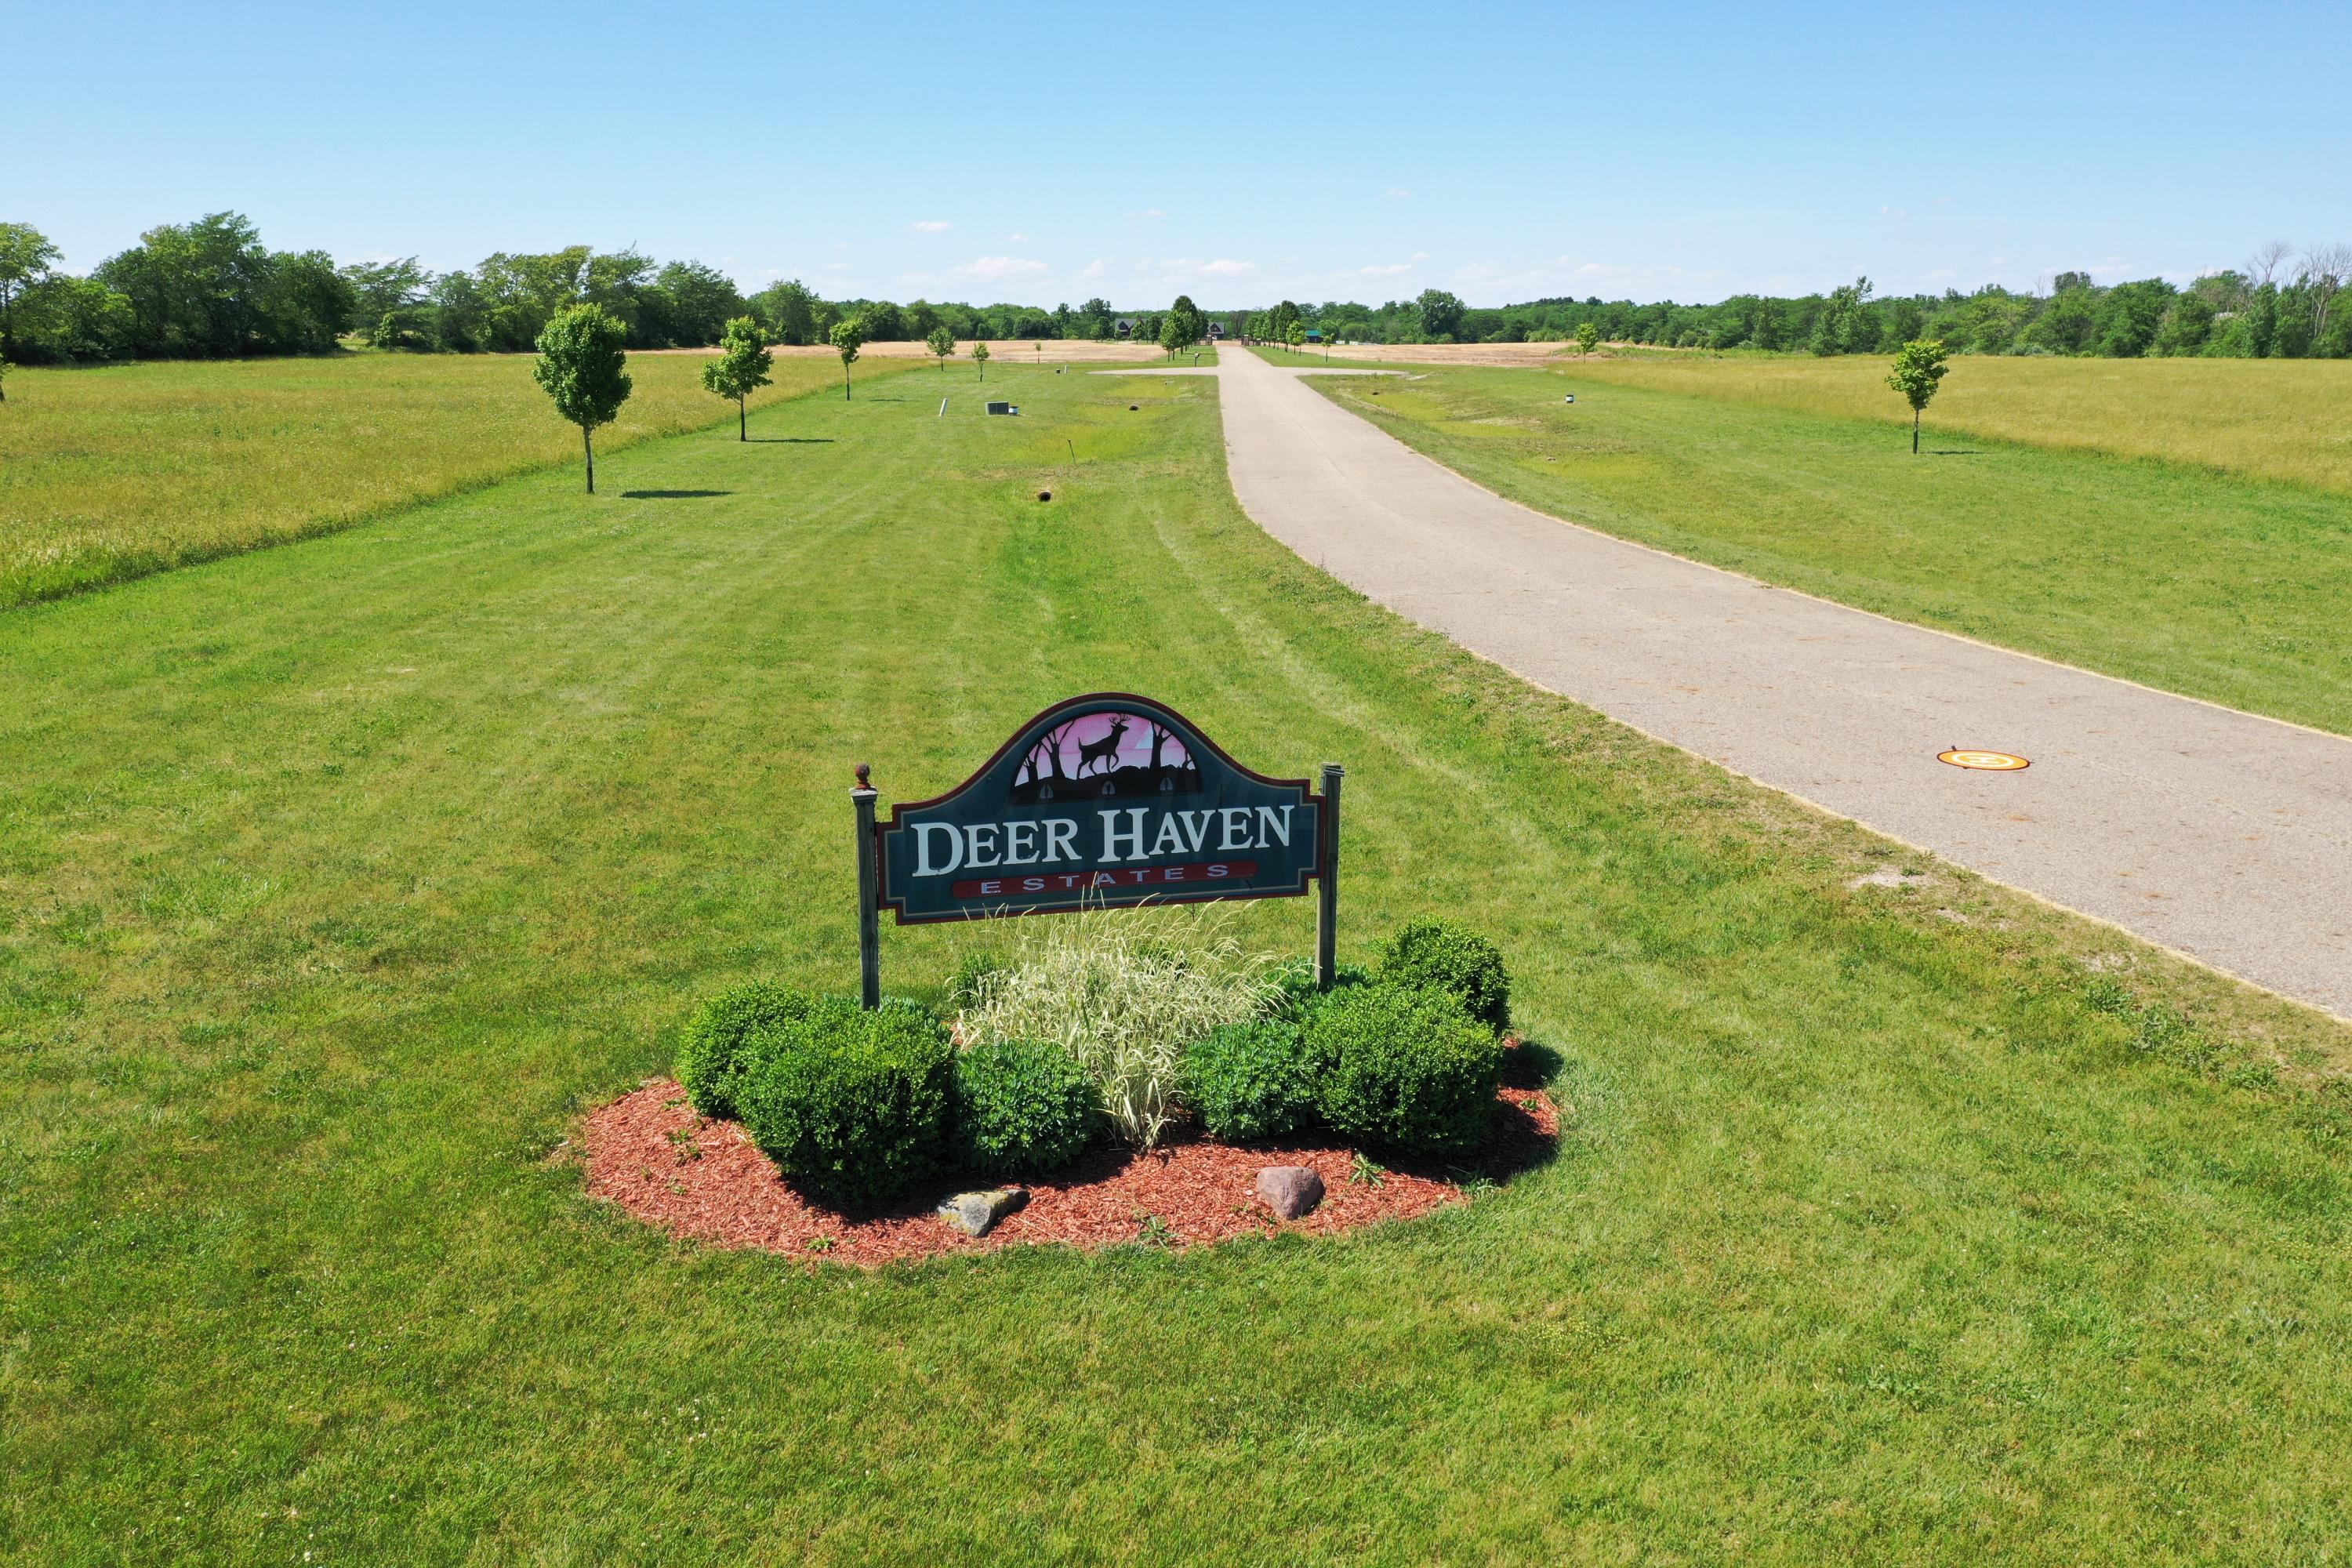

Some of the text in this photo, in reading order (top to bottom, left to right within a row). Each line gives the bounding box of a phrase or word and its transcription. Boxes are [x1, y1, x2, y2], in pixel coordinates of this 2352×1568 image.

[911, 804, 1294, 877] DEER HAVEN
[981, 864, 1229, 894] ESTATES
